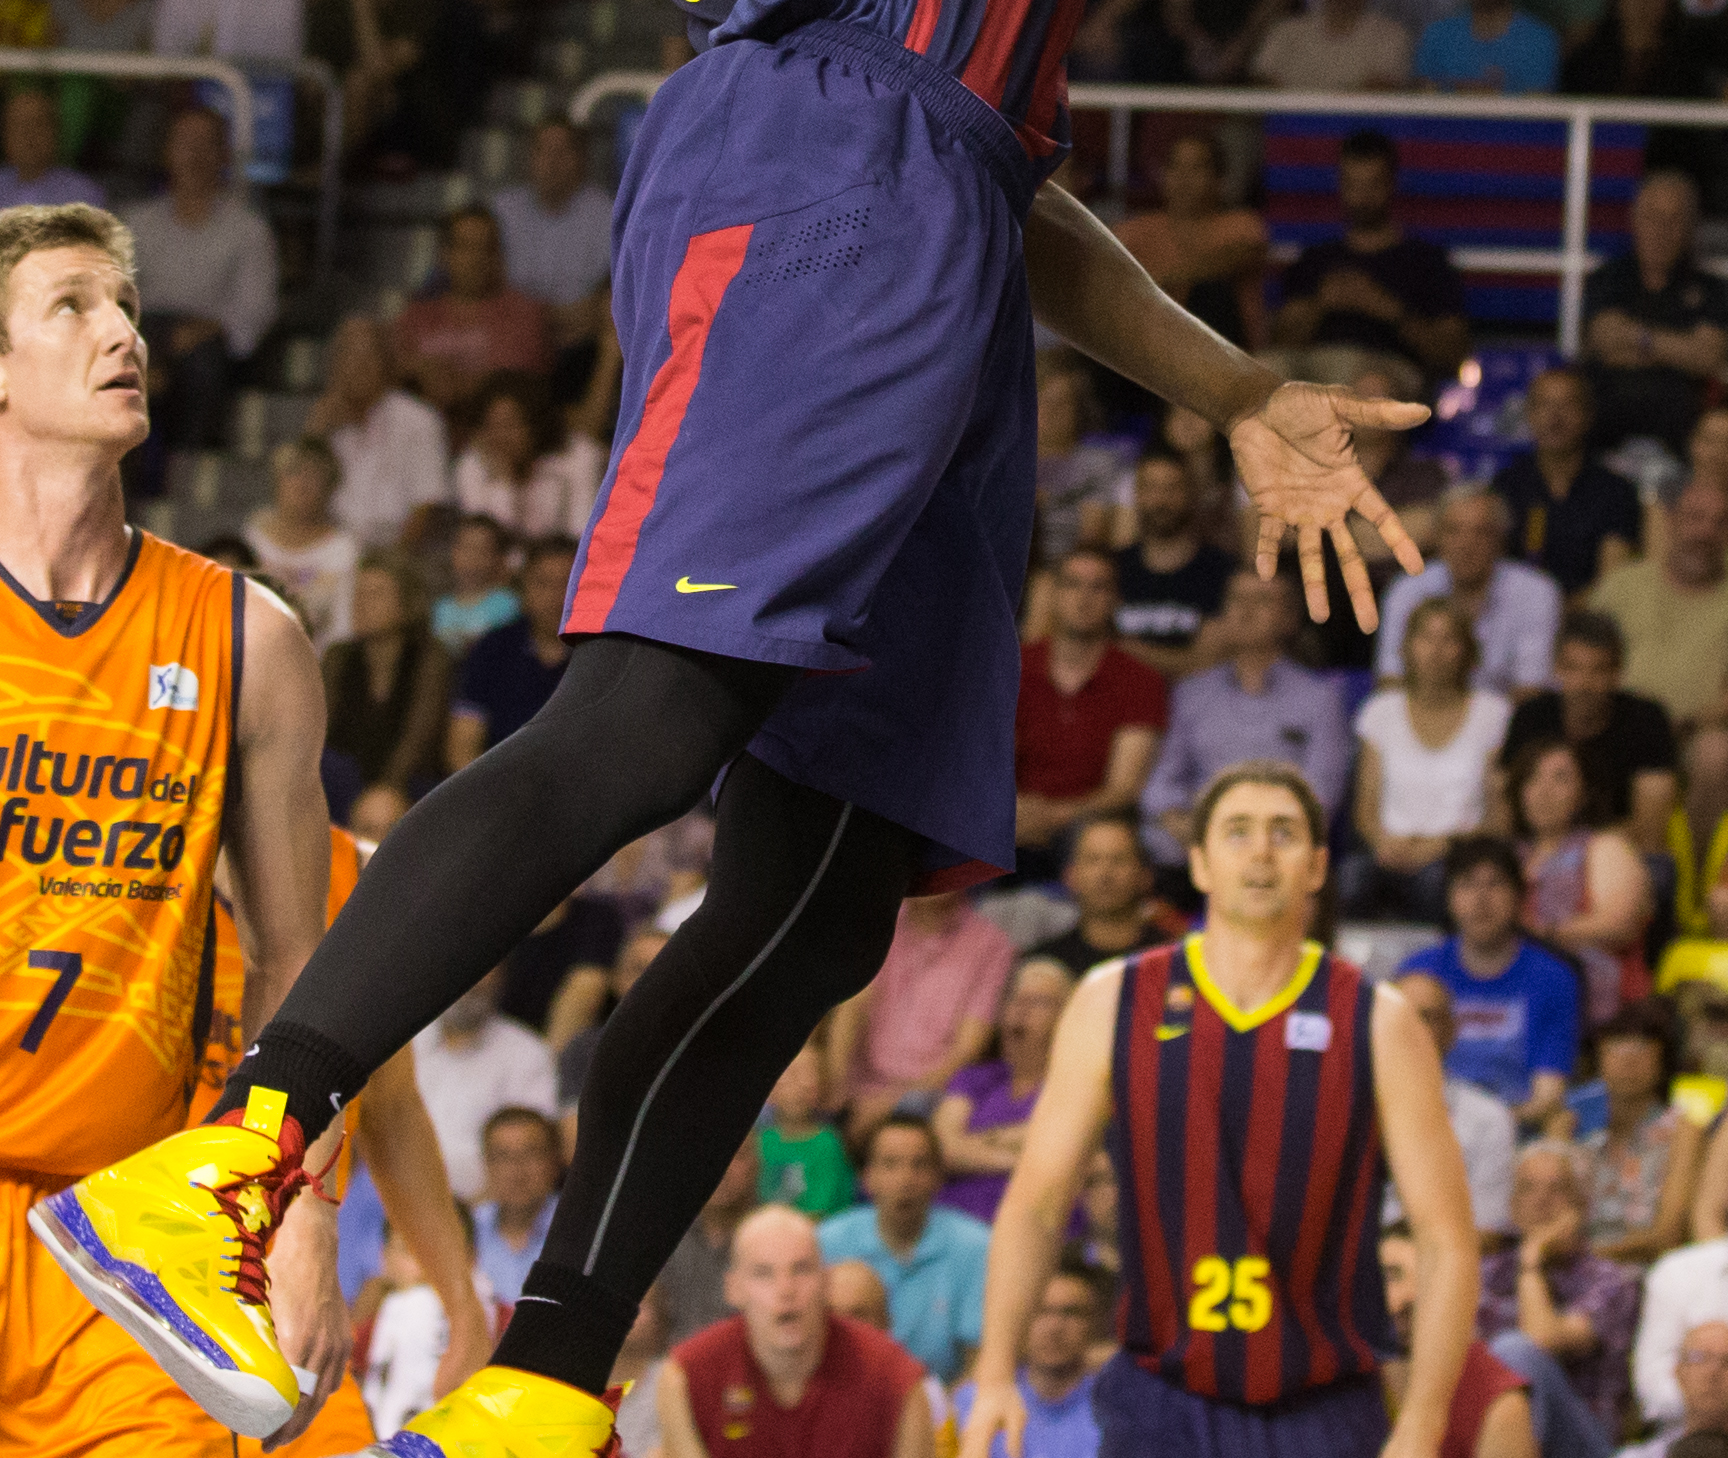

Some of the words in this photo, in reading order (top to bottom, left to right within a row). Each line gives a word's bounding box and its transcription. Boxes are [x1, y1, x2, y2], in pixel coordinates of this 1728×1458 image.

[149, 772, 196, 805] del
[38, 875, 123, 899] Valencia
[19, 948, 84, 1055] 7
[1187, 1254, 1273, 1333] 25
